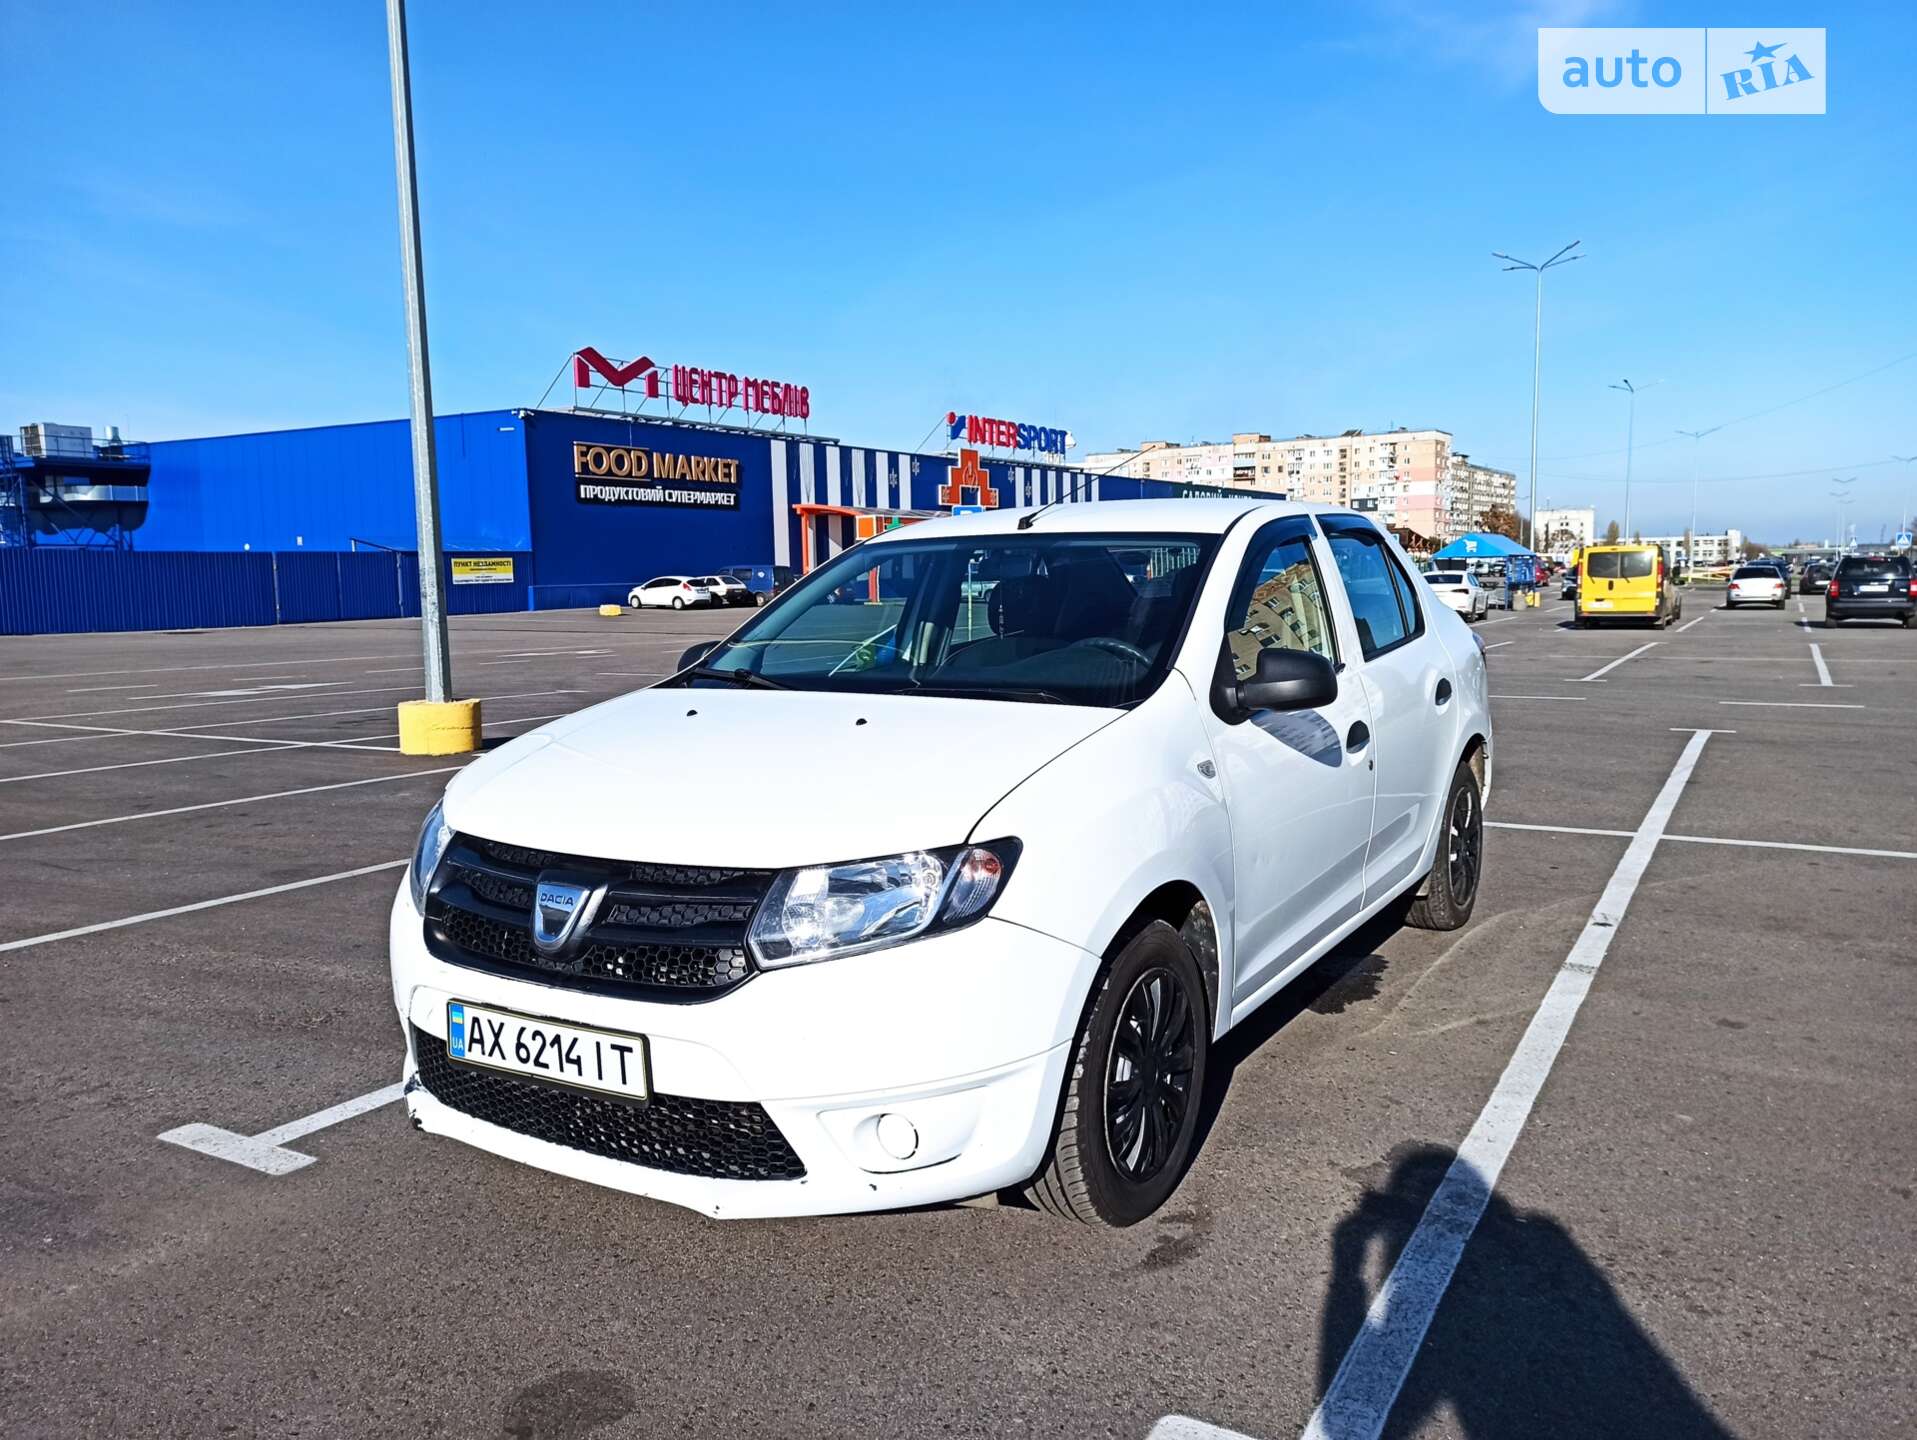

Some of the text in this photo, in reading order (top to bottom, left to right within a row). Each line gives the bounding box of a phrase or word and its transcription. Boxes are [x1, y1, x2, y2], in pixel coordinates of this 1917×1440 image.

[672, 364, 738, 408] ЦЕНТР
[743, 376, 810, 419] МЕБЛІВ
[967, 414, 1067, 454] INTERSPORT
[574, 446, 739, 484] FOOD MARKET
[580, 484, 736, 506] ПРОДУКТОВИЙ СУПЕРМАРКЕТ
[540, 892, 574, 906] DACIA
[452, 1016, 634, 1086] UA AX 6214 IT
